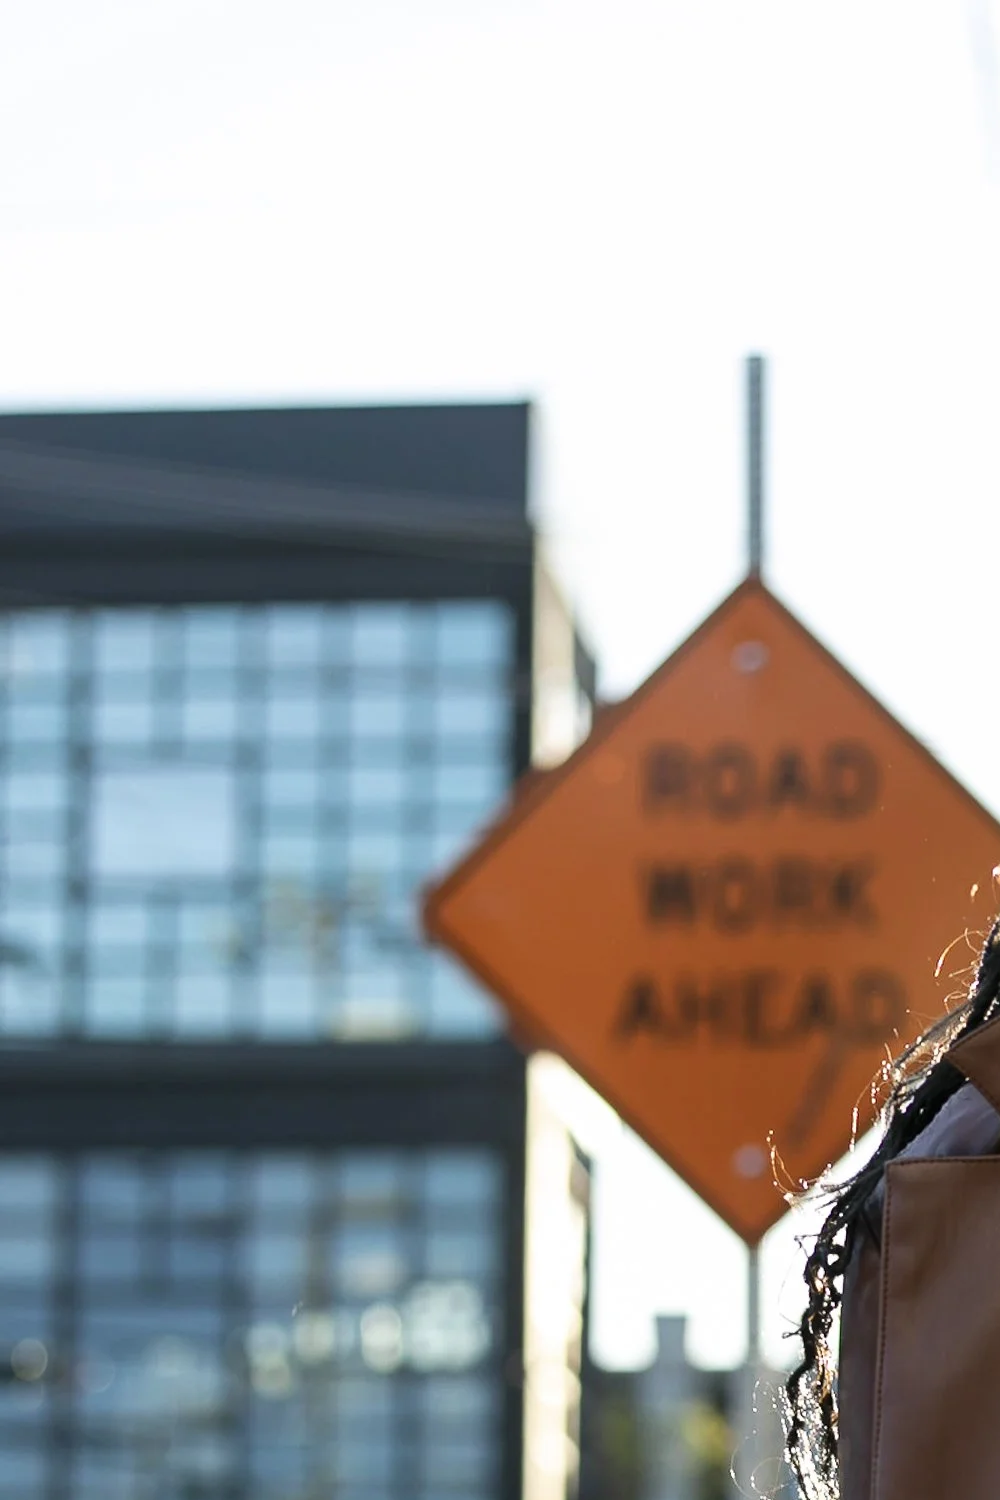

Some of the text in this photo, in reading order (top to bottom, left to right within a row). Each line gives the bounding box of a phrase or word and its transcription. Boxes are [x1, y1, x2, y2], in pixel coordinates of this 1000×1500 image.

[643, 742, 883, 818] ROAD
[645, 858, 877, 934] WORK
[613, 972, 905, 1048] AHEAD
